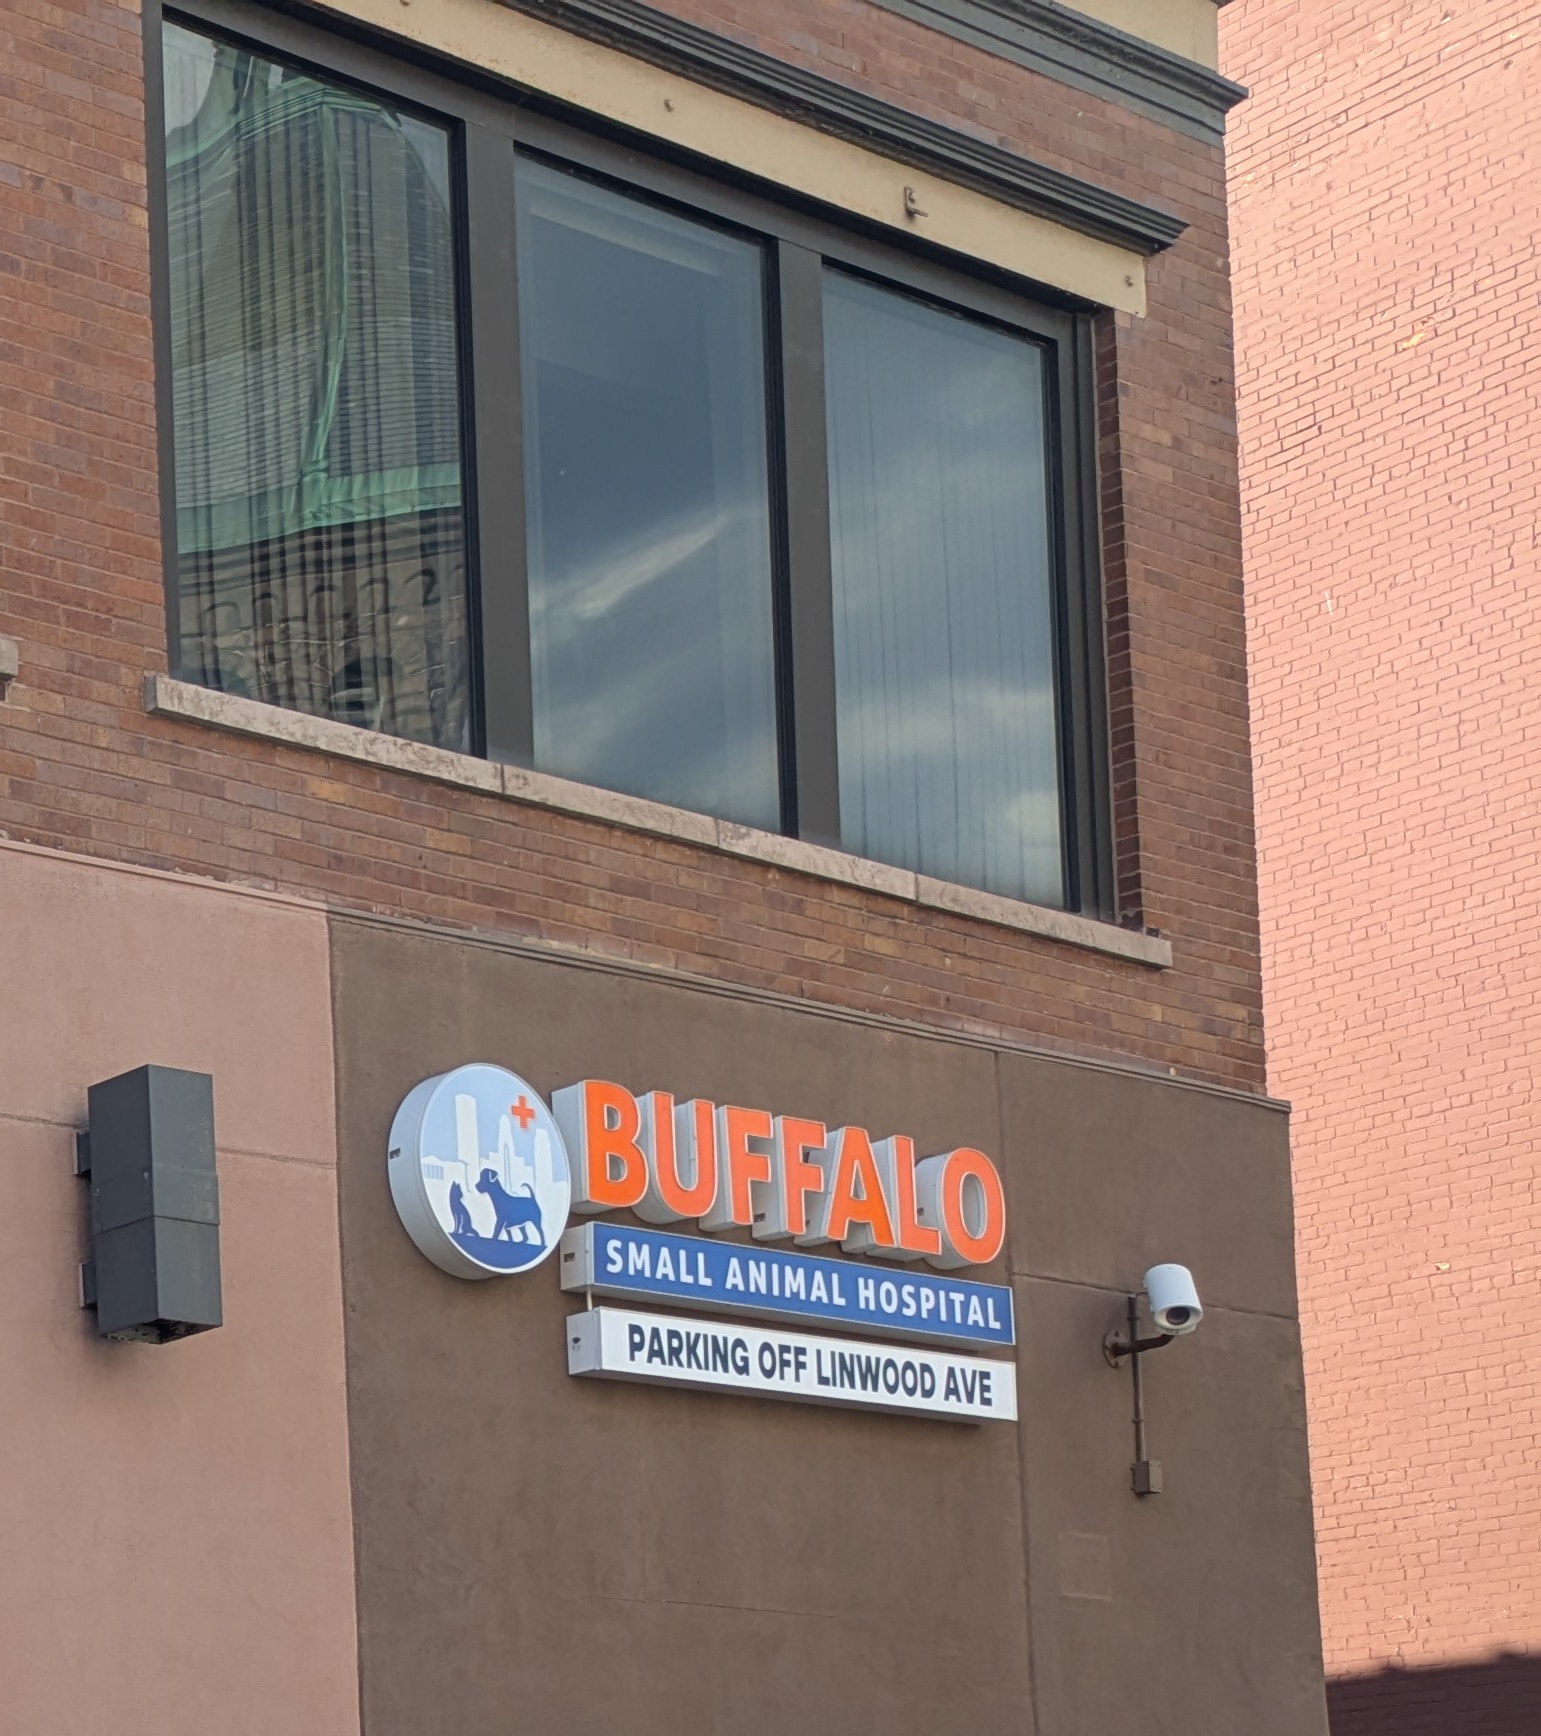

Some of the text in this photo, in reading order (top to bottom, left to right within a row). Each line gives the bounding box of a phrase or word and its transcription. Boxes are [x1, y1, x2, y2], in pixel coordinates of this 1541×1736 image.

[583, 1080, 1004, 1264] BUFFALO
[606, 1239, 1001, 1330] SMALL ANIMAL HOSPITAL
[628, 1323, 993, 1407] PARKING OFF LINWOOD AVE
